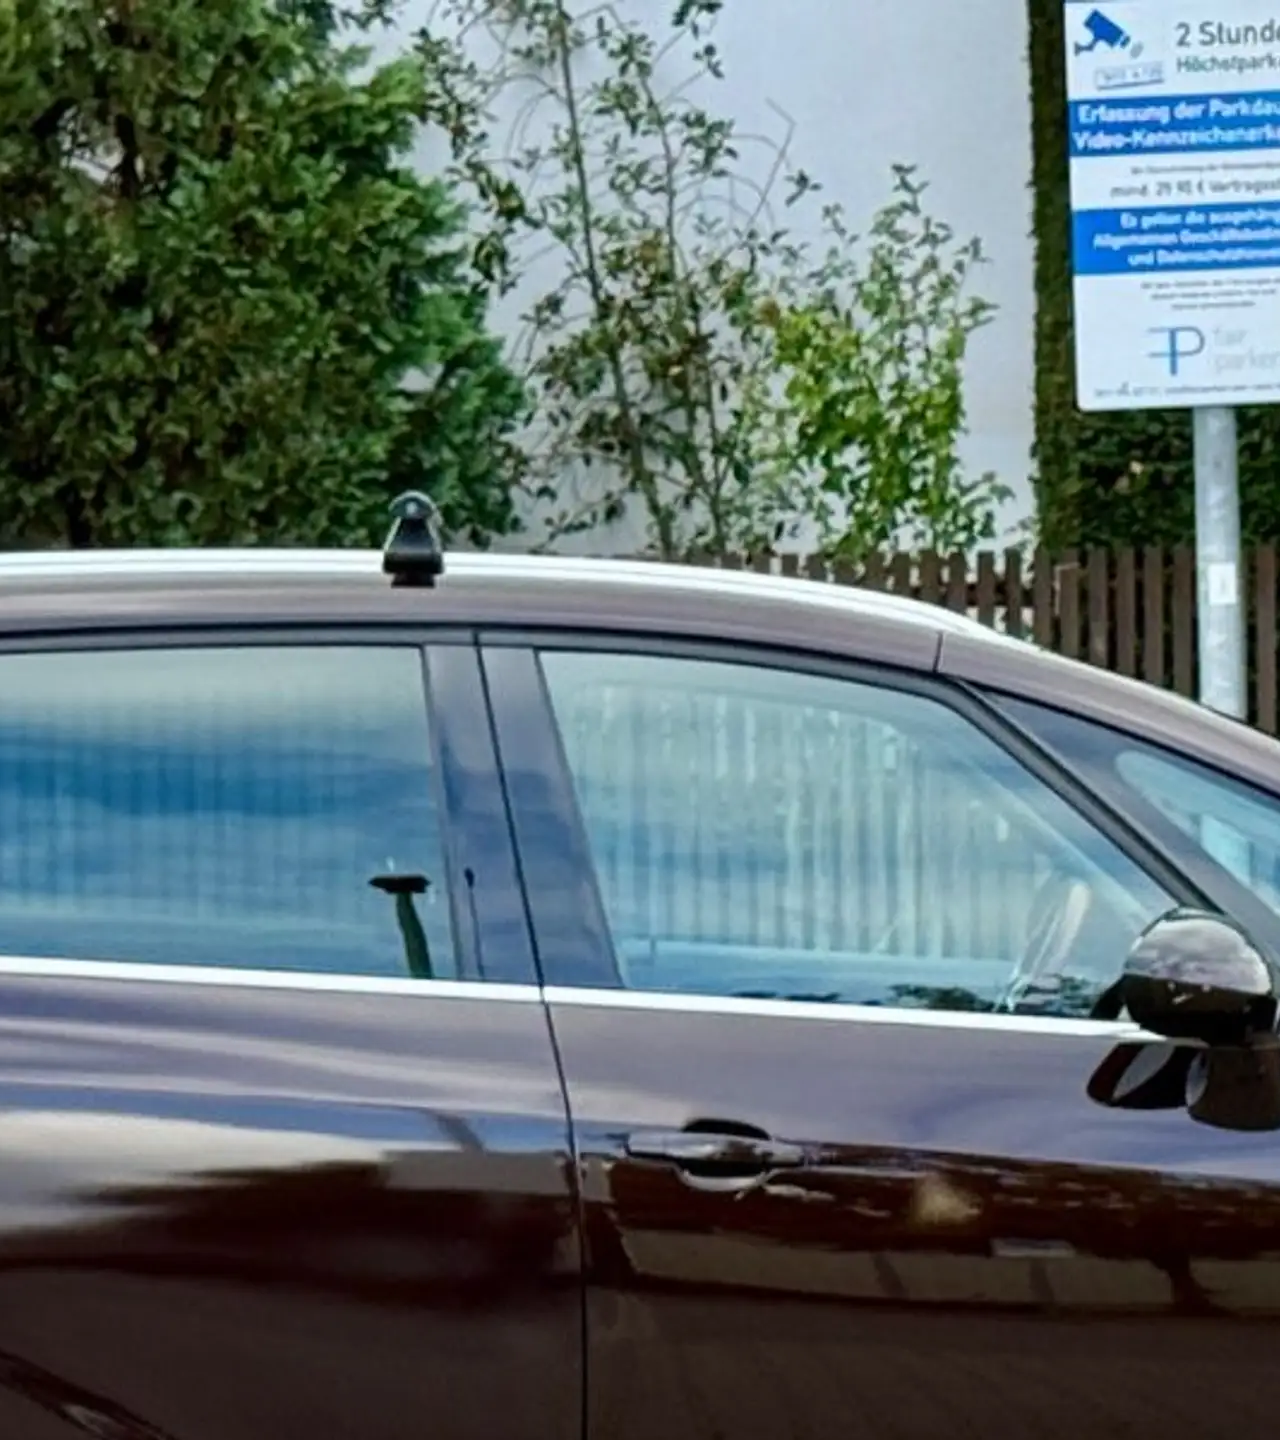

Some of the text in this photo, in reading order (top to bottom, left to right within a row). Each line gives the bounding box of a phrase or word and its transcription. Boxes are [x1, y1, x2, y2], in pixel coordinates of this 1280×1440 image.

[1176, 22, 1191, 47] 2
[1077, 103, 1170, 125] Erfassung
[1173, 101, 1206, 120] der
